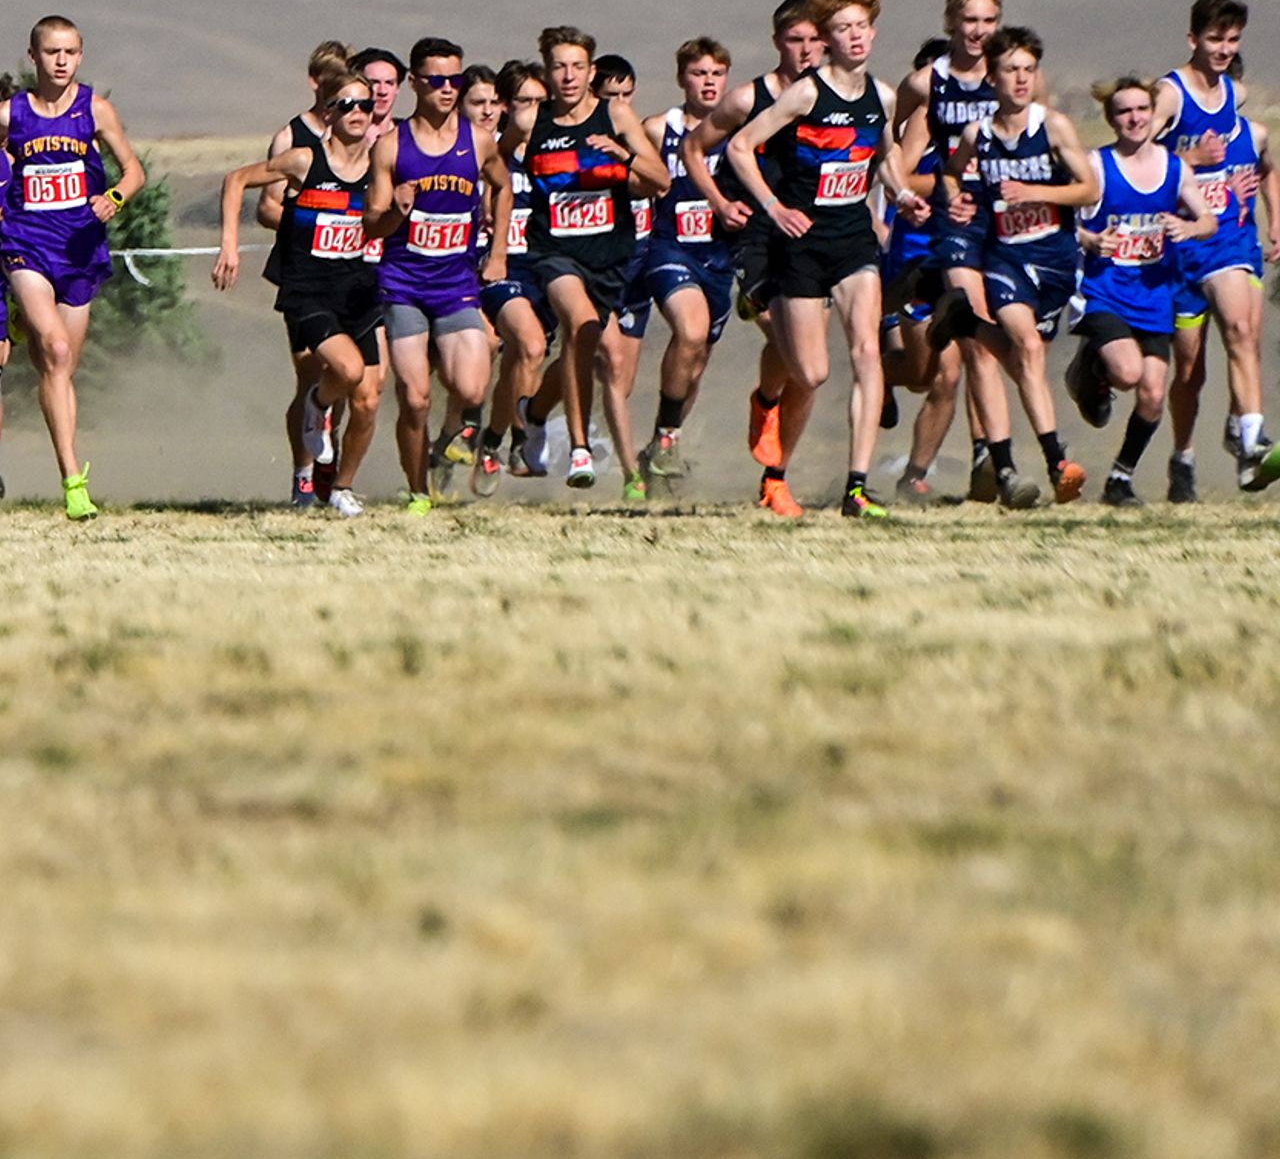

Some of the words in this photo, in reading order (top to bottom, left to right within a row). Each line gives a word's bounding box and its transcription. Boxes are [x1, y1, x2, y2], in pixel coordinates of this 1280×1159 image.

[23, 135, 88, 157] EWISTON
[28, 174, 80, 203] 0510
[419, 174, 474, 197] WISTON
[823, 172, 869, 199] 0427
[557, 197, 608, 229] 0429
[1001, 206, 1052, 235] 0320
[414, 223, 465, 250] 0514
